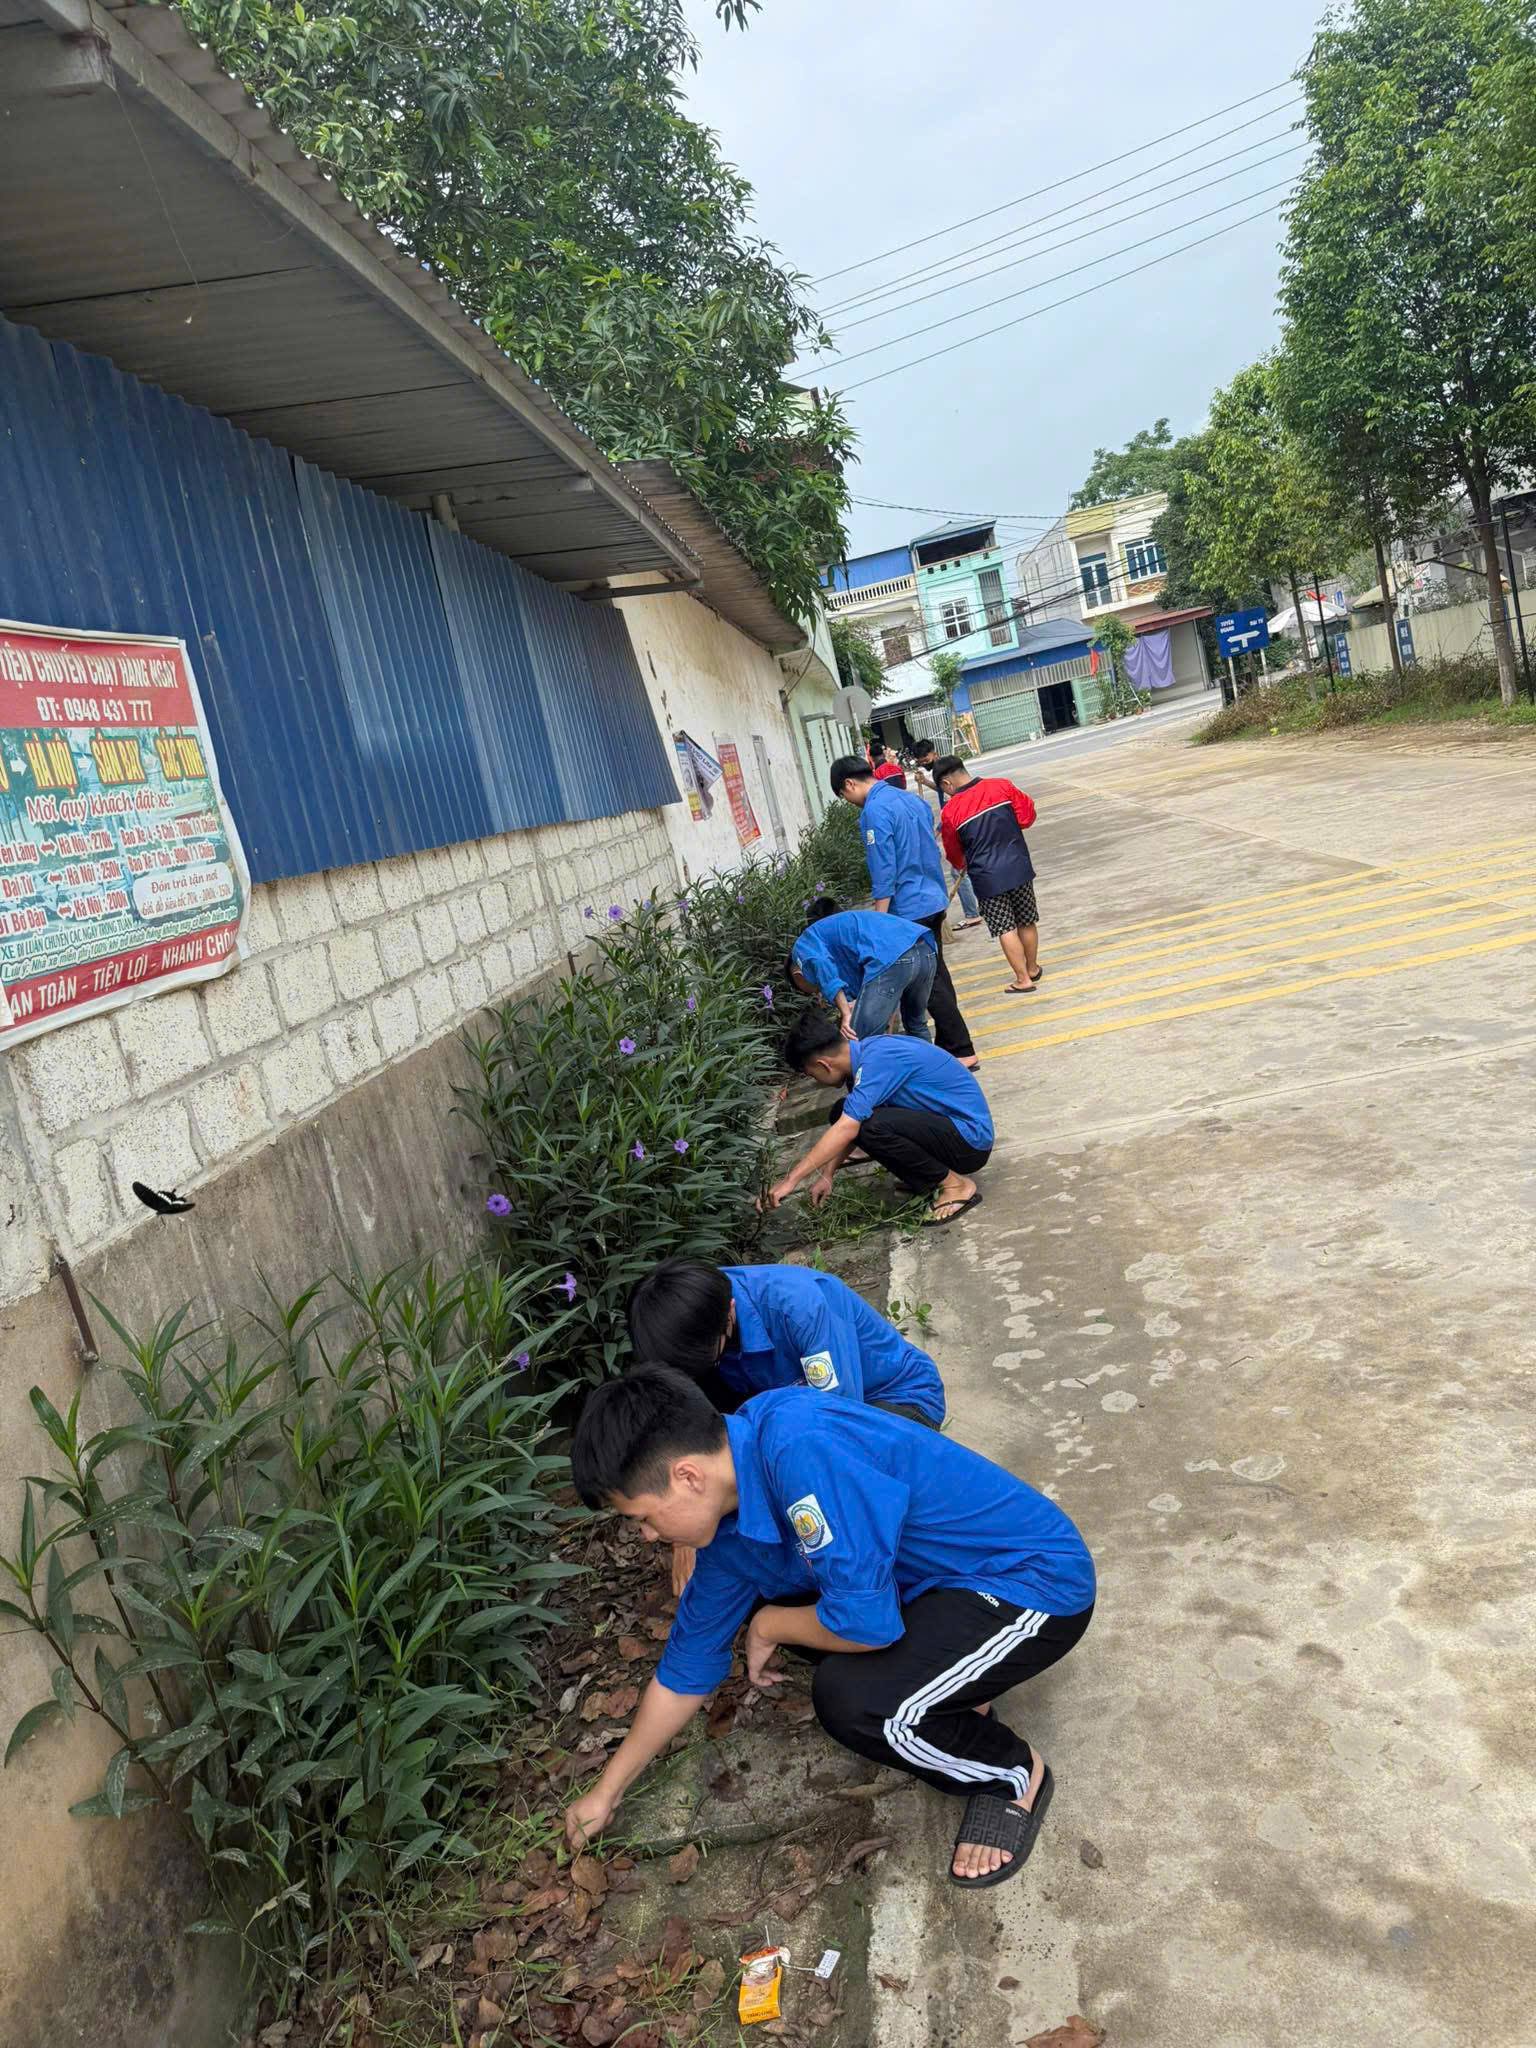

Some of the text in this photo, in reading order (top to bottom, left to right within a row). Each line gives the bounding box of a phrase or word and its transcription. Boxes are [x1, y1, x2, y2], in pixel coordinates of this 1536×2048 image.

[30, 643, 88, 684] CHUYẾN
[84, 654, 119, 693] CHẠY
[117, 650, 152, 687] HÀNG
[36, 696, 153, 722] ĐT: 0948 431 777
[26, 796, 59, 823] Mời
[61, 794, 87, 824] quý
[90, 791, 133, 814] khách
[136, 789, 156, 814] đặt
[151, 880, 170, 894] Đón
[189, 872, 204, 887] tận
[1, 943, 16, 961] XE
[10, 991, 33, 1019] AN
[38, 975, 77, 1011] TOÀN
[93, 960, 123, 993] TIỆN
[127, 953, 148, 984] LỢI
[161, 940, 203, 970] NHANH
